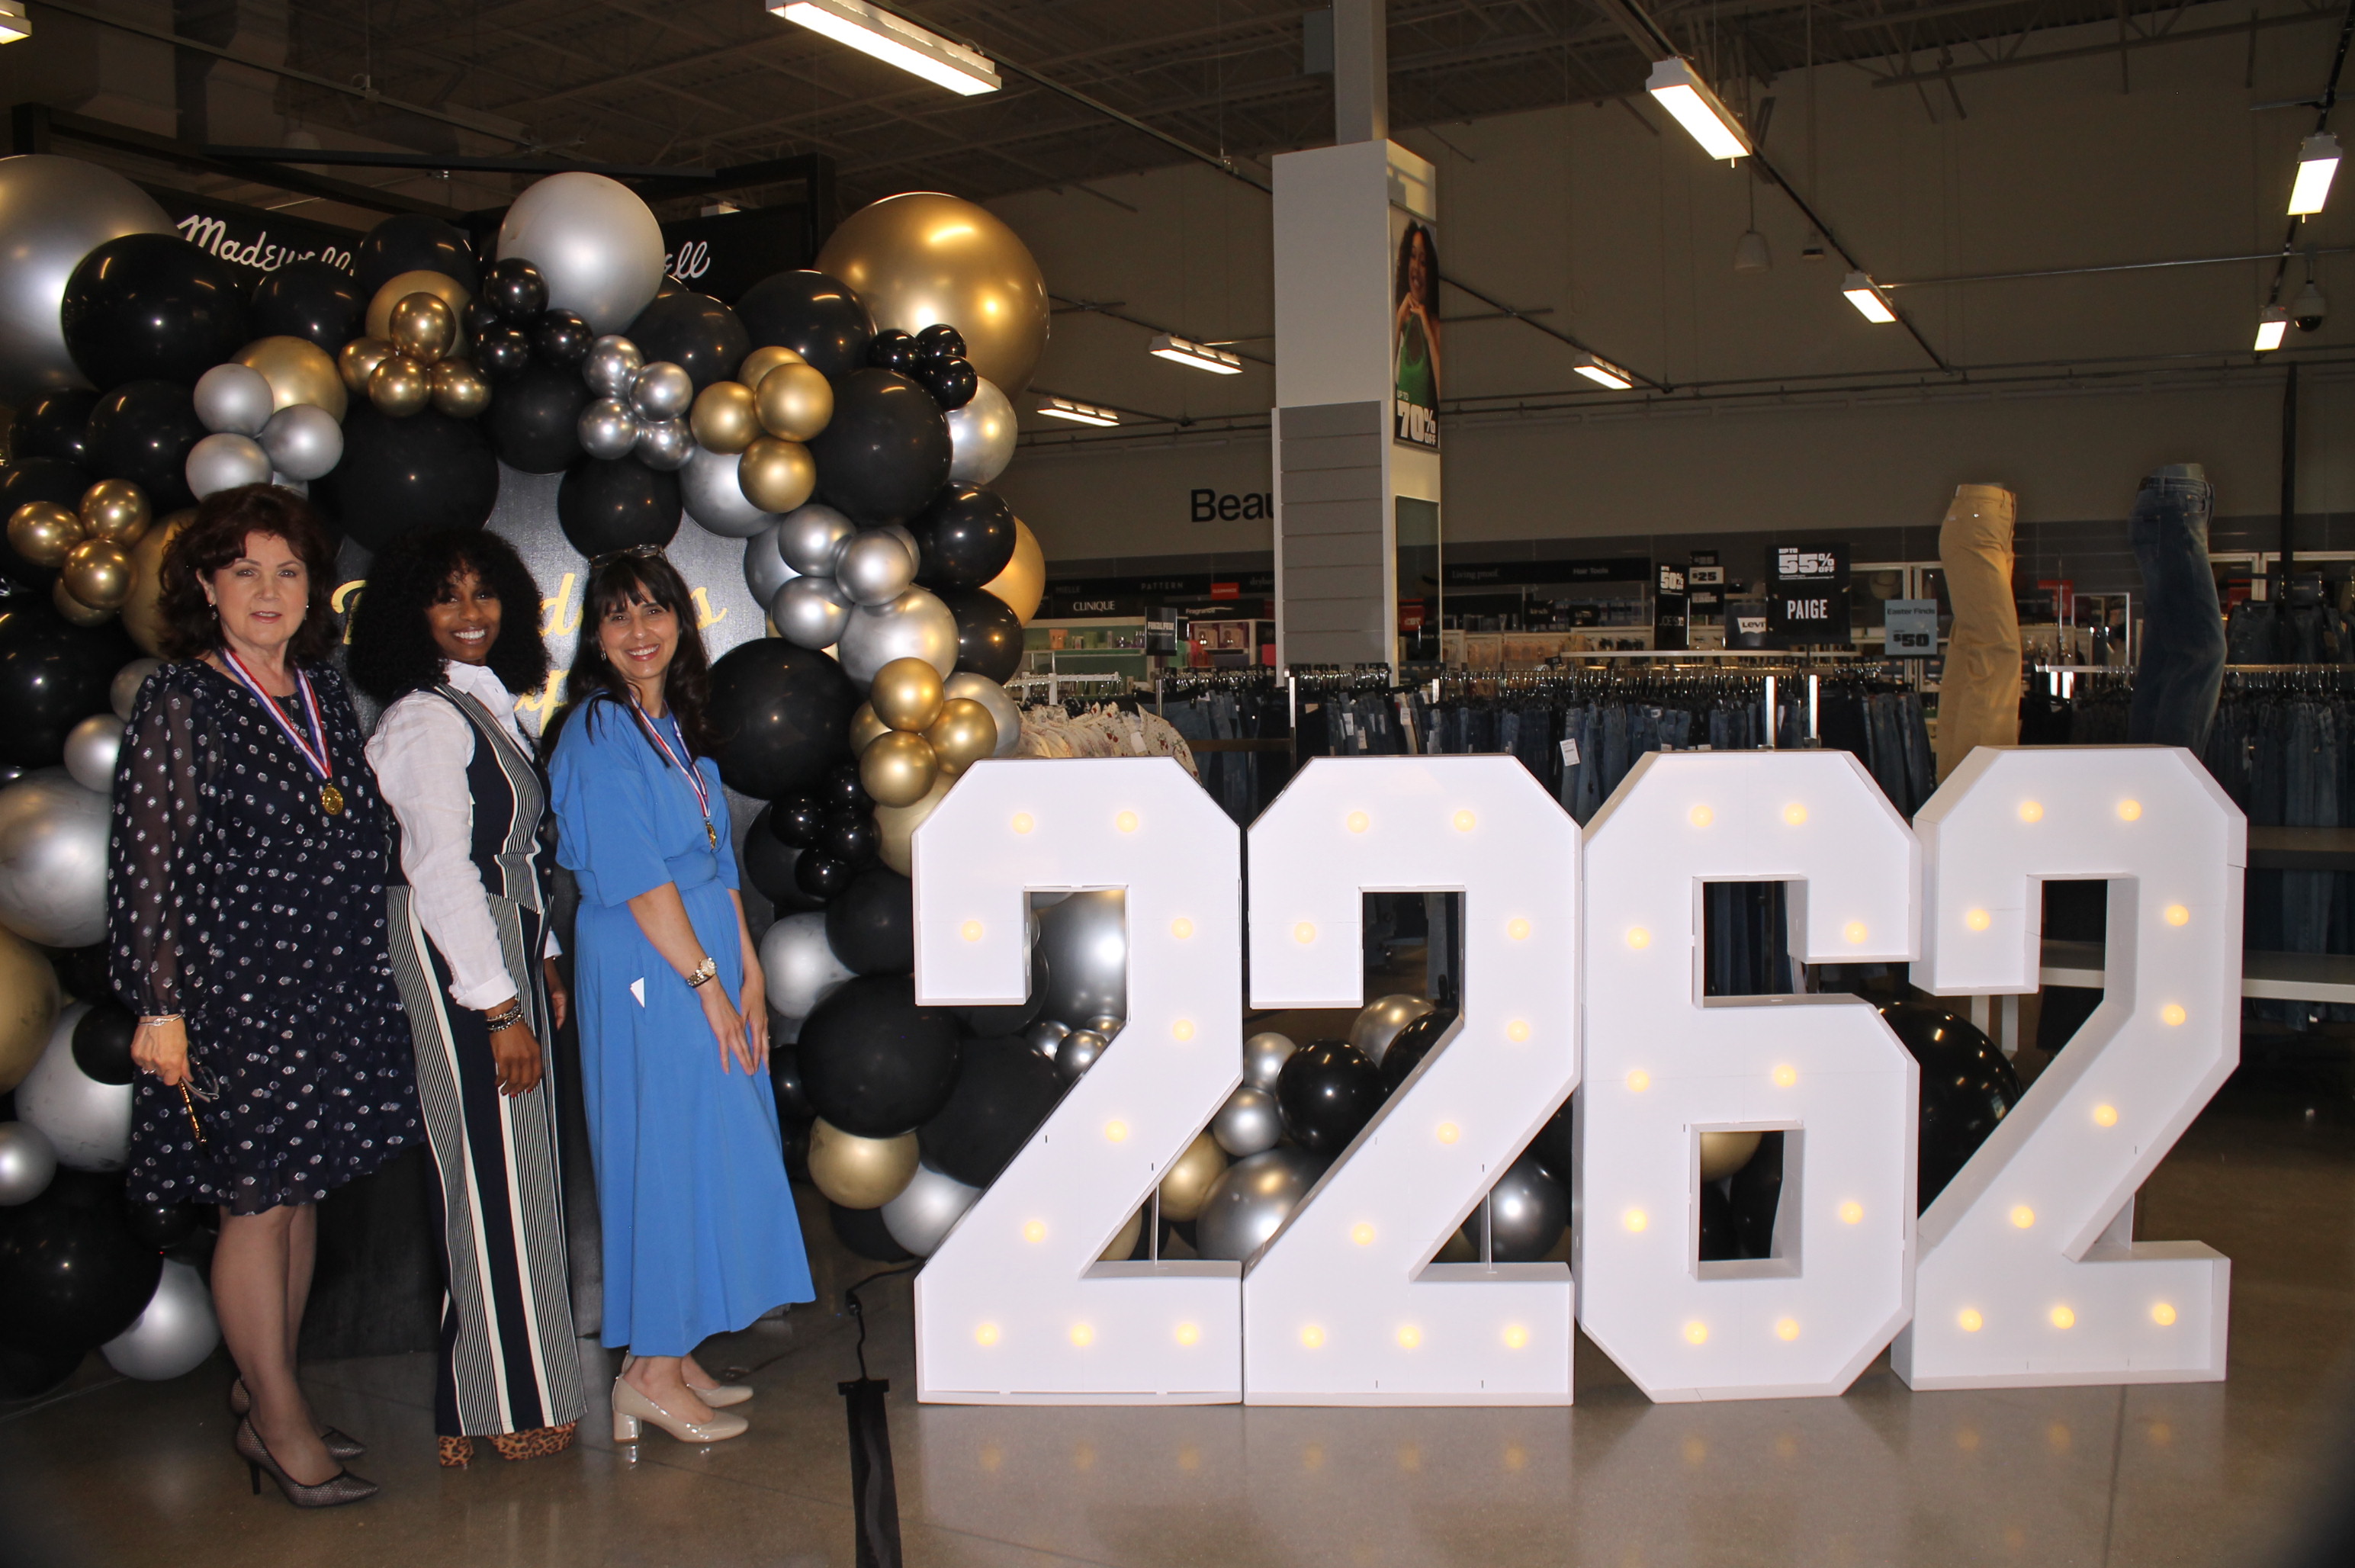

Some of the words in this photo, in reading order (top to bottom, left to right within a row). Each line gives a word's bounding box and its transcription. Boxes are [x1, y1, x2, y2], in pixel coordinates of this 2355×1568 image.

[1397, 399, 1436, 442] 70%
[1778, 553, 1835, 574] 55%
[1453, 569, 1476, 580] Living
[1692, 572, 1717, 581] $25
[1141, 581, 1184, 590] PATTERN
[1073, 600, 1116, 612] CLINIQUE
[1787, 599, 1828, 620] PAIGE
[1894, 633, 1929, 647] $50
[913, 743, 2248, 1406] 2262
